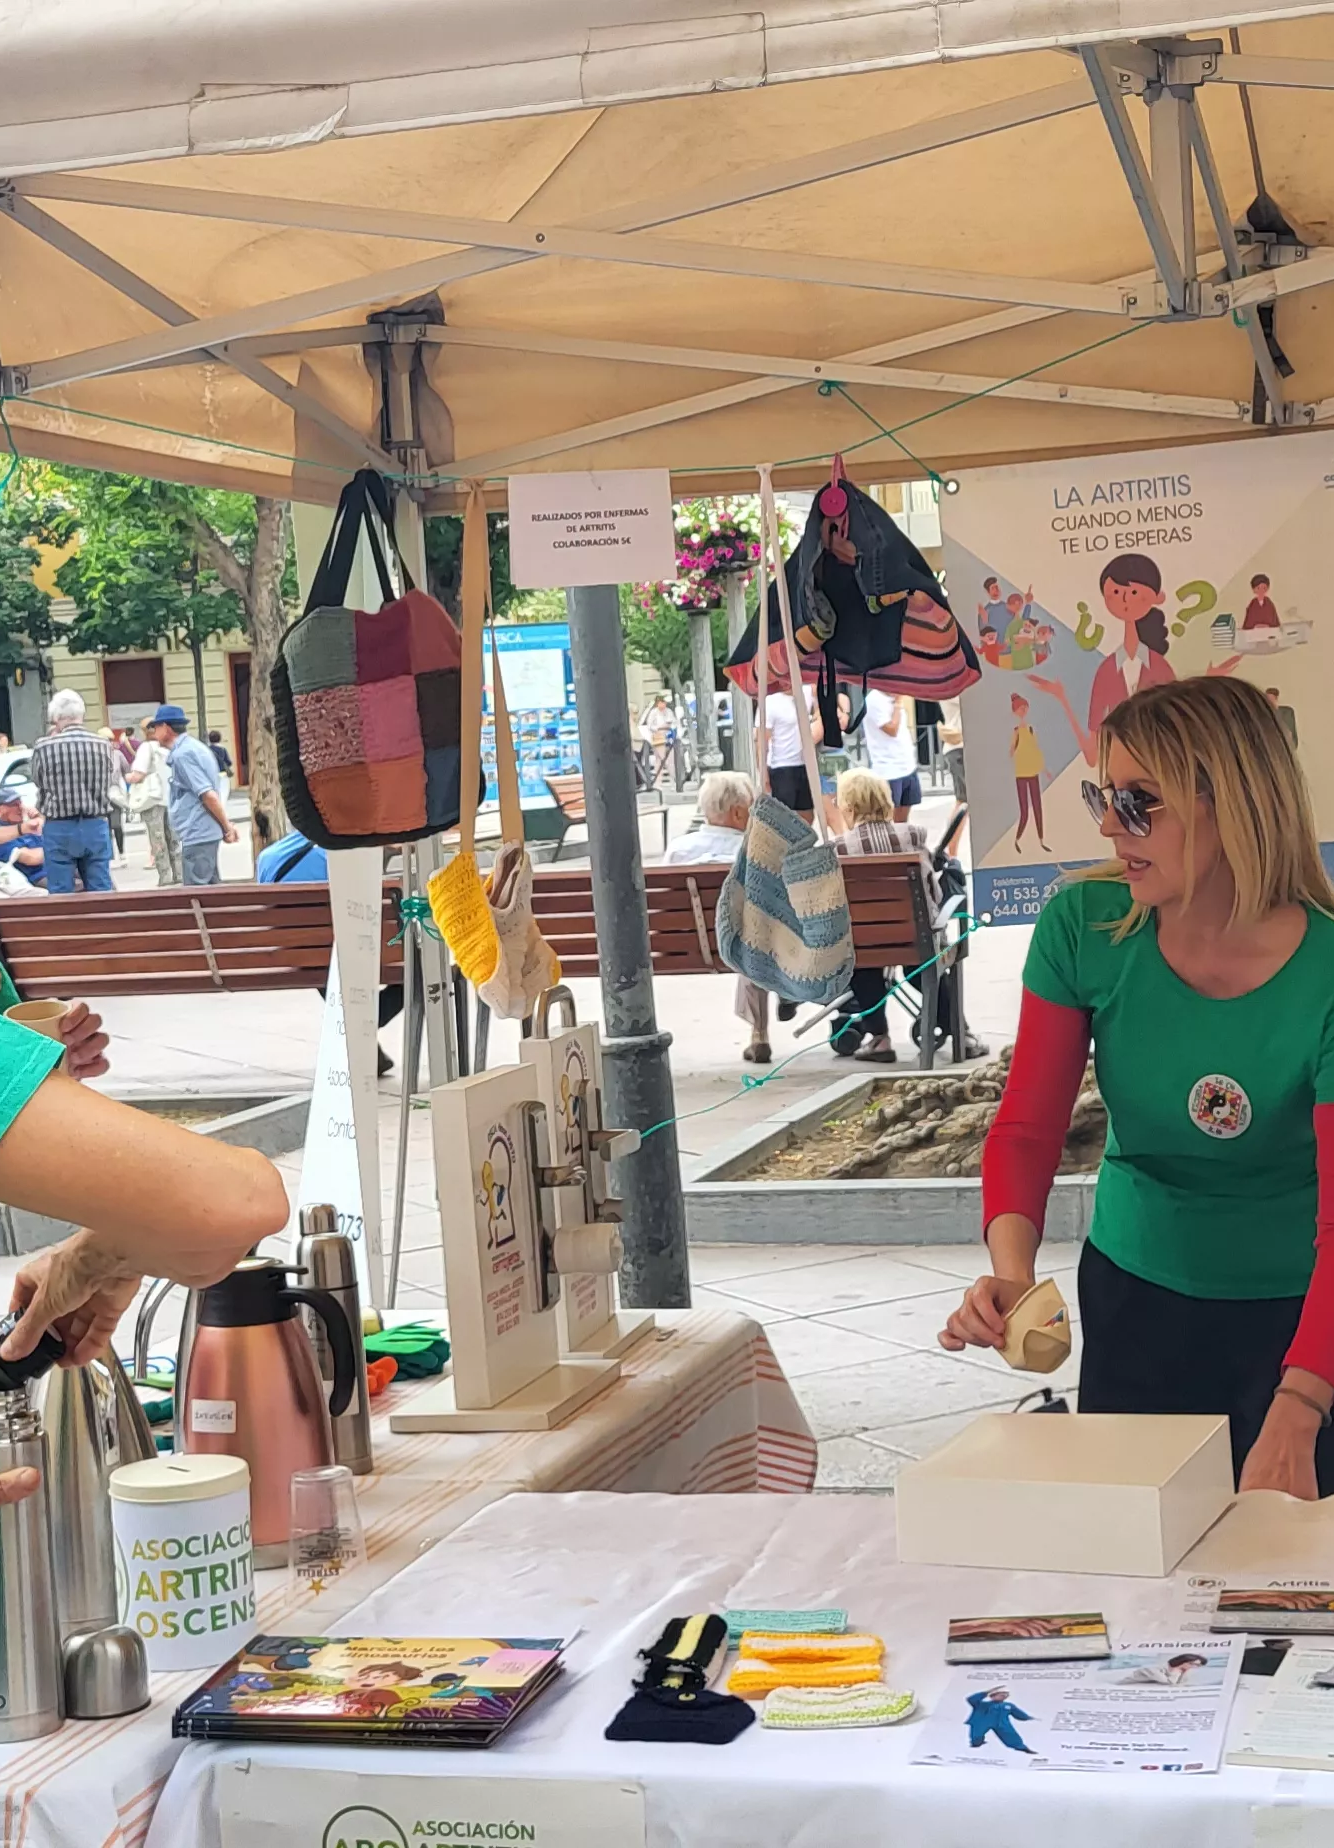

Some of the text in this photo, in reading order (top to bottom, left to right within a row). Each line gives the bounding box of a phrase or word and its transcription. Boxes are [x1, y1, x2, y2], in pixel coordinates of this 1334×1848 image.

[1054, 474, 1191, 509] LA ARTRITIS
[531, 508, 649, 522] REALIZADOS POR ENFERMAS
[1051, 502, 1203, 532] CUANDO MENOS
[566, 523, 616, 533] DE ARTRITIS
[553, 537, 619, 549] COLABORACIÓN
[1060, 526, 1192, 554] TE LO ESPERAS
[992, 889, 1007, 902] 91
[1014, 887, 1039, 900] 535
[993, 902, 1040, 917] 644 00
[1267, 1579, 1330, 1588] Artritis
[1137, 1639, 1233, 1649] ansiedad
[412, 1820, 536, 1841] ASOCIACIÓN
